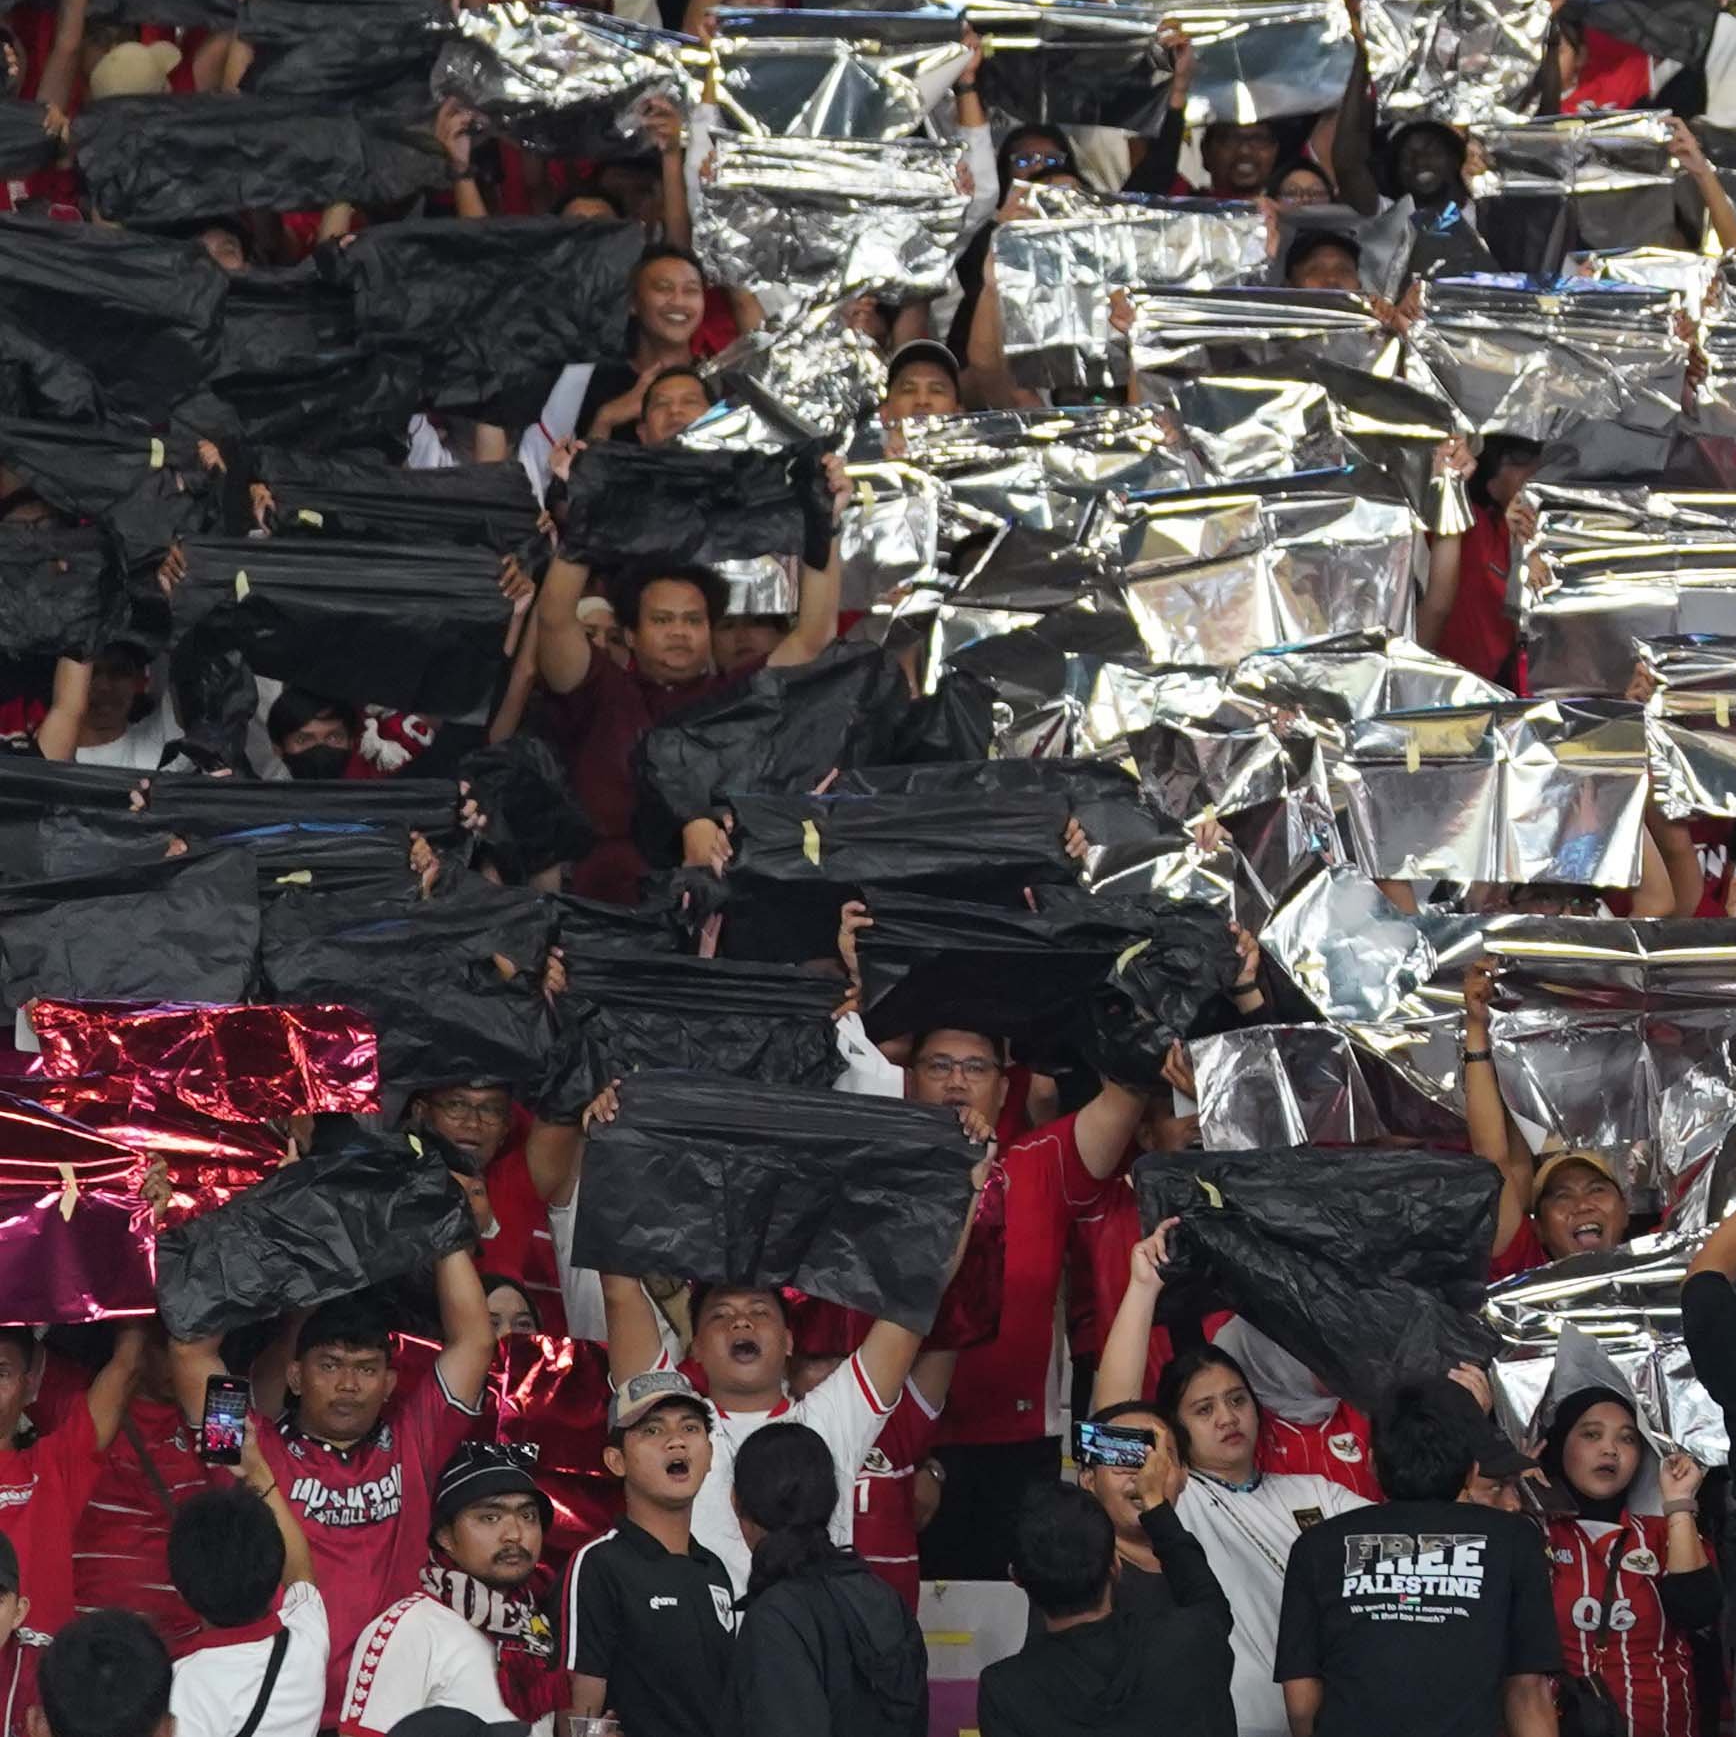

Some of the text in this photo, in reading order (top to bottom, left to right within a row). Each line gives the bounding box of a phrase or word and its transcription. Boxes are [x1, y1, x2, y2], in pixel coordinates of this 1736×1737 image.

[1344, 1533, 1488, 1578] FREE
[1342, 1574, 1482, 1600] PALESTINE
[1415, 1614, 1446, 1623] much?
[1422, 1606, 1452, 1614] normal
[1572, 1596, 1637, 1631] 06
